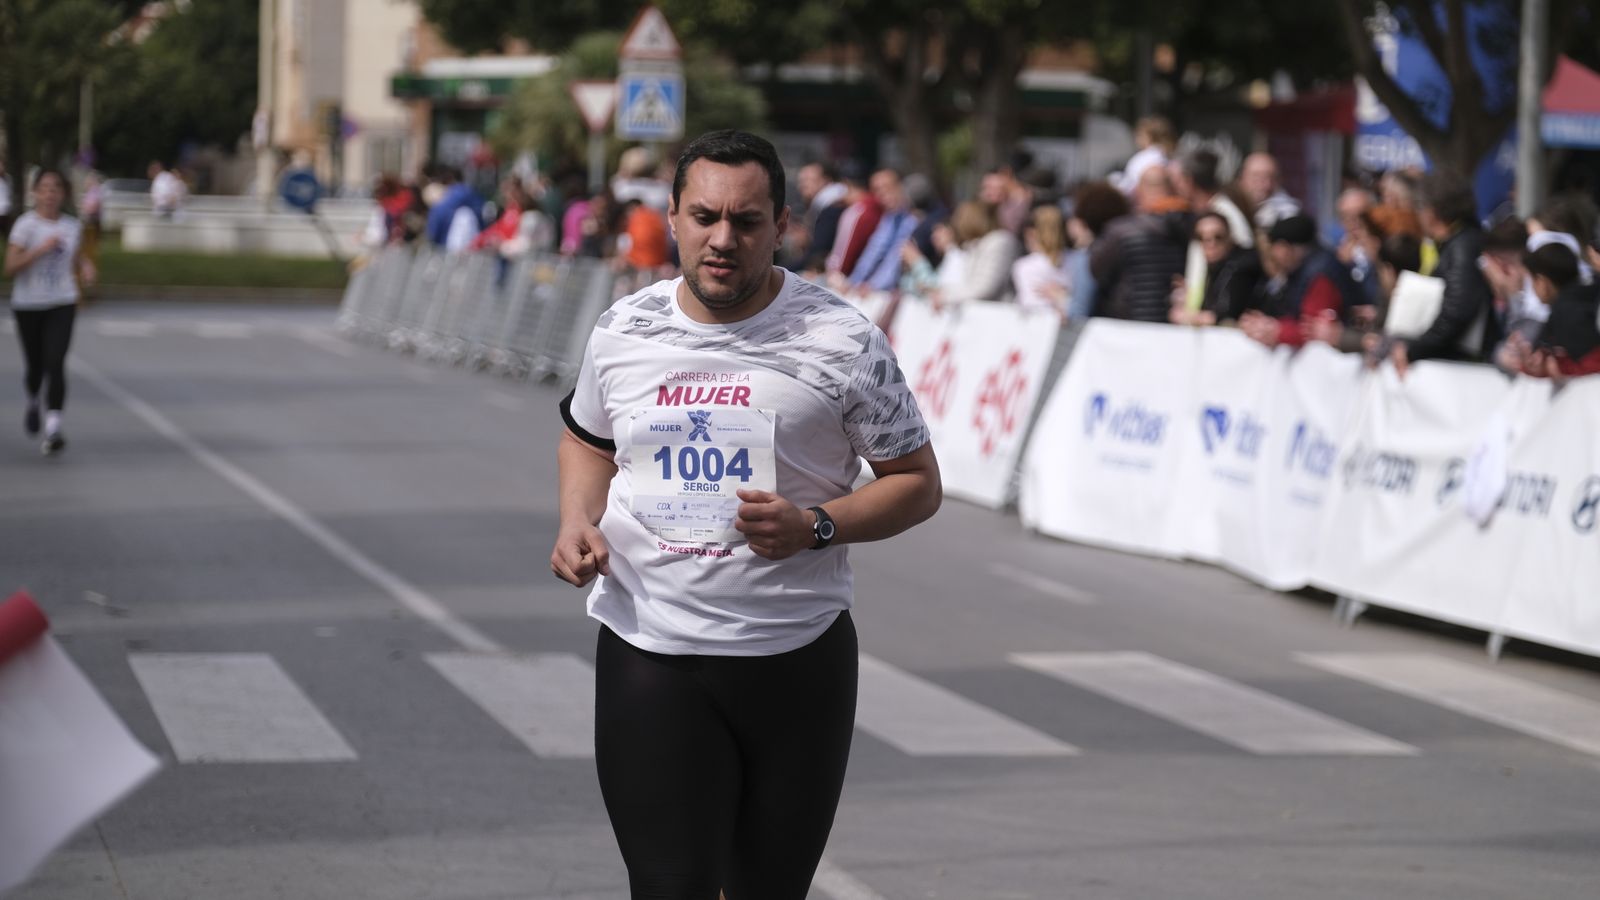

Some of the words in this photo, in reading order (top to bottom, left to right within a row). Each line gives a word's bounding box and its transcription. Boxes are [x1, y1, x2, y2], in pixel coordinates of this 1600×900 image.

[666, 371, 718, 382] CARRERA
[720, 373, 735, 383] DE
[737, 373, 750, 382] LA
[656, 385, 751, 407] MUJER
[649, 424, 682, 432] MUJER
[654, 446, 753, 482] 1004
[683, 482, 720, 492] SERGIO
[656, 502, 672, 511] CDX
[667, 544, 707, 556] NUESTRA
[708, 548, 735, 557] META.
